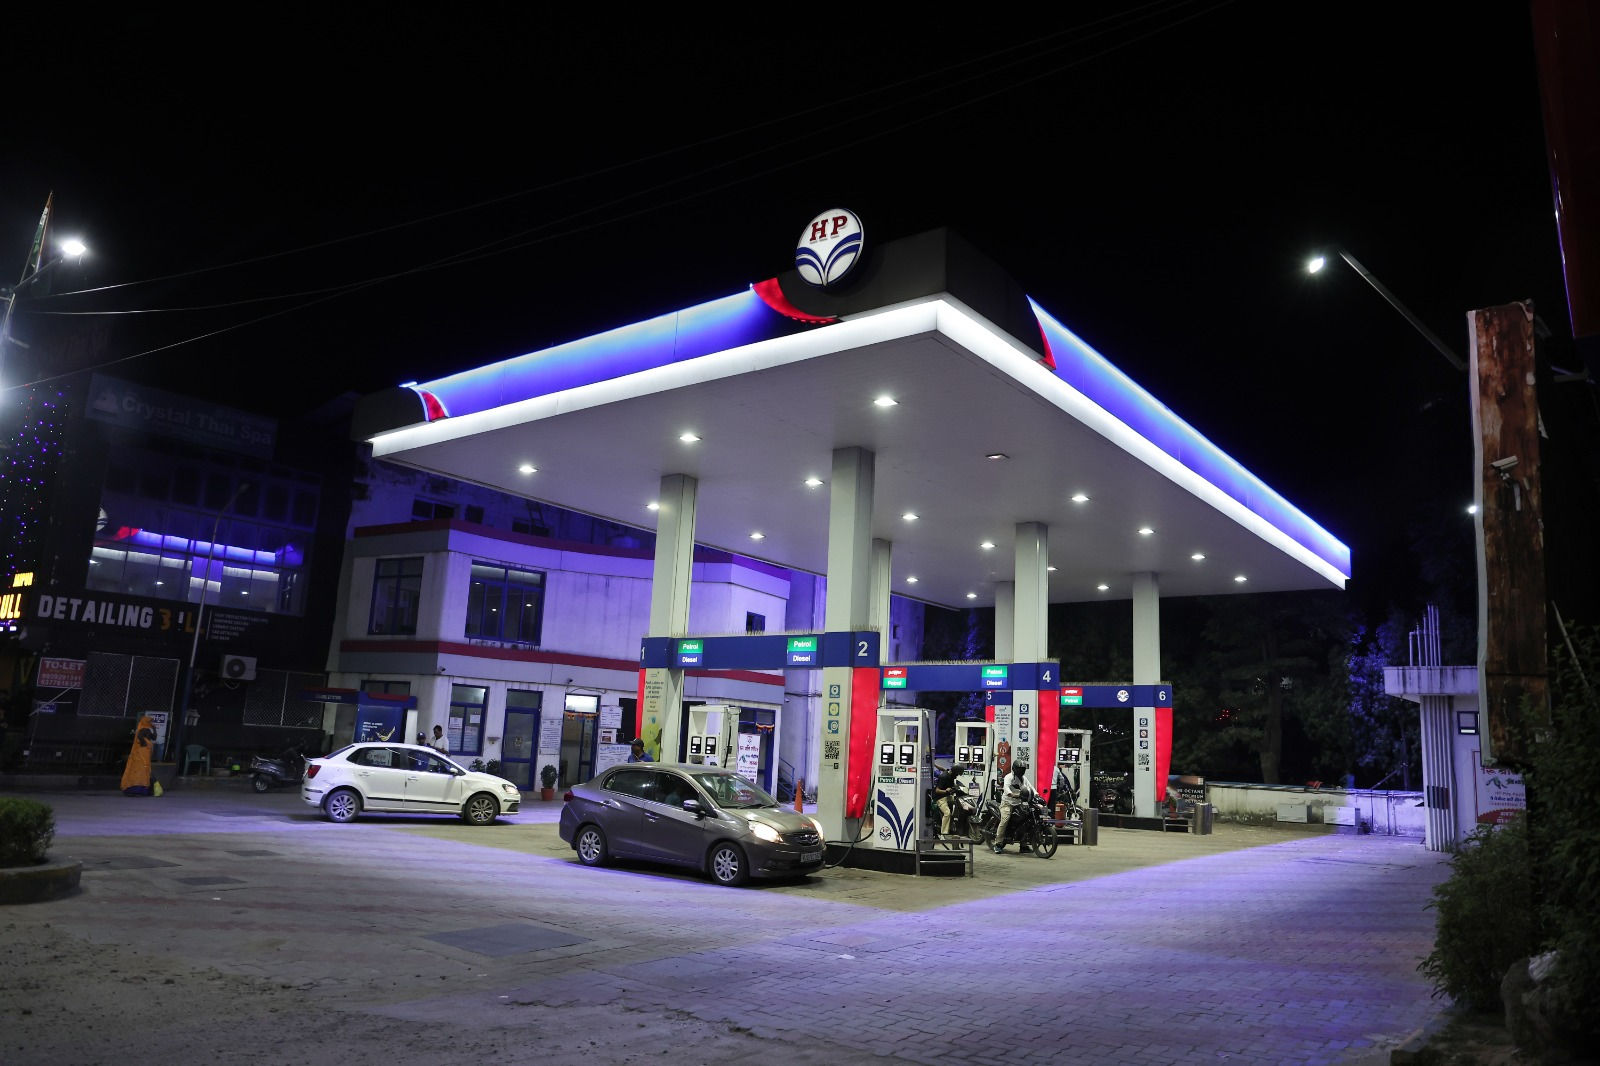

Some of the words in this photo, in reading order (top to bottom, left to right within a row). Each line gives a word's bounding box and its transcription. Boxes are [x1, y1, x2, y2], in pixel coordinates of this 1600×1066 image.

[809, 214, 848, 242] HP
[121, 393, 191, 425] Crystal
[239, 424, 273, 445] Spa
[38, 594, 154, 629] DETAILING
[682, 643, 699, 651] Petrol
[793, 640, 812, 648] Petrol
[857, 640, 869, 657] 2
[681, 655, 698, 664] Diesel
[44, 660, 84, 671] TO-LET
[986, 668, 1003, 676] Petrol
[1042, 670, 1052, 683] 4
[986, 679, 1003, 687] Diesel
[986, 691, 992, 700] 5
[1158, 690, 1167, 701] 6
